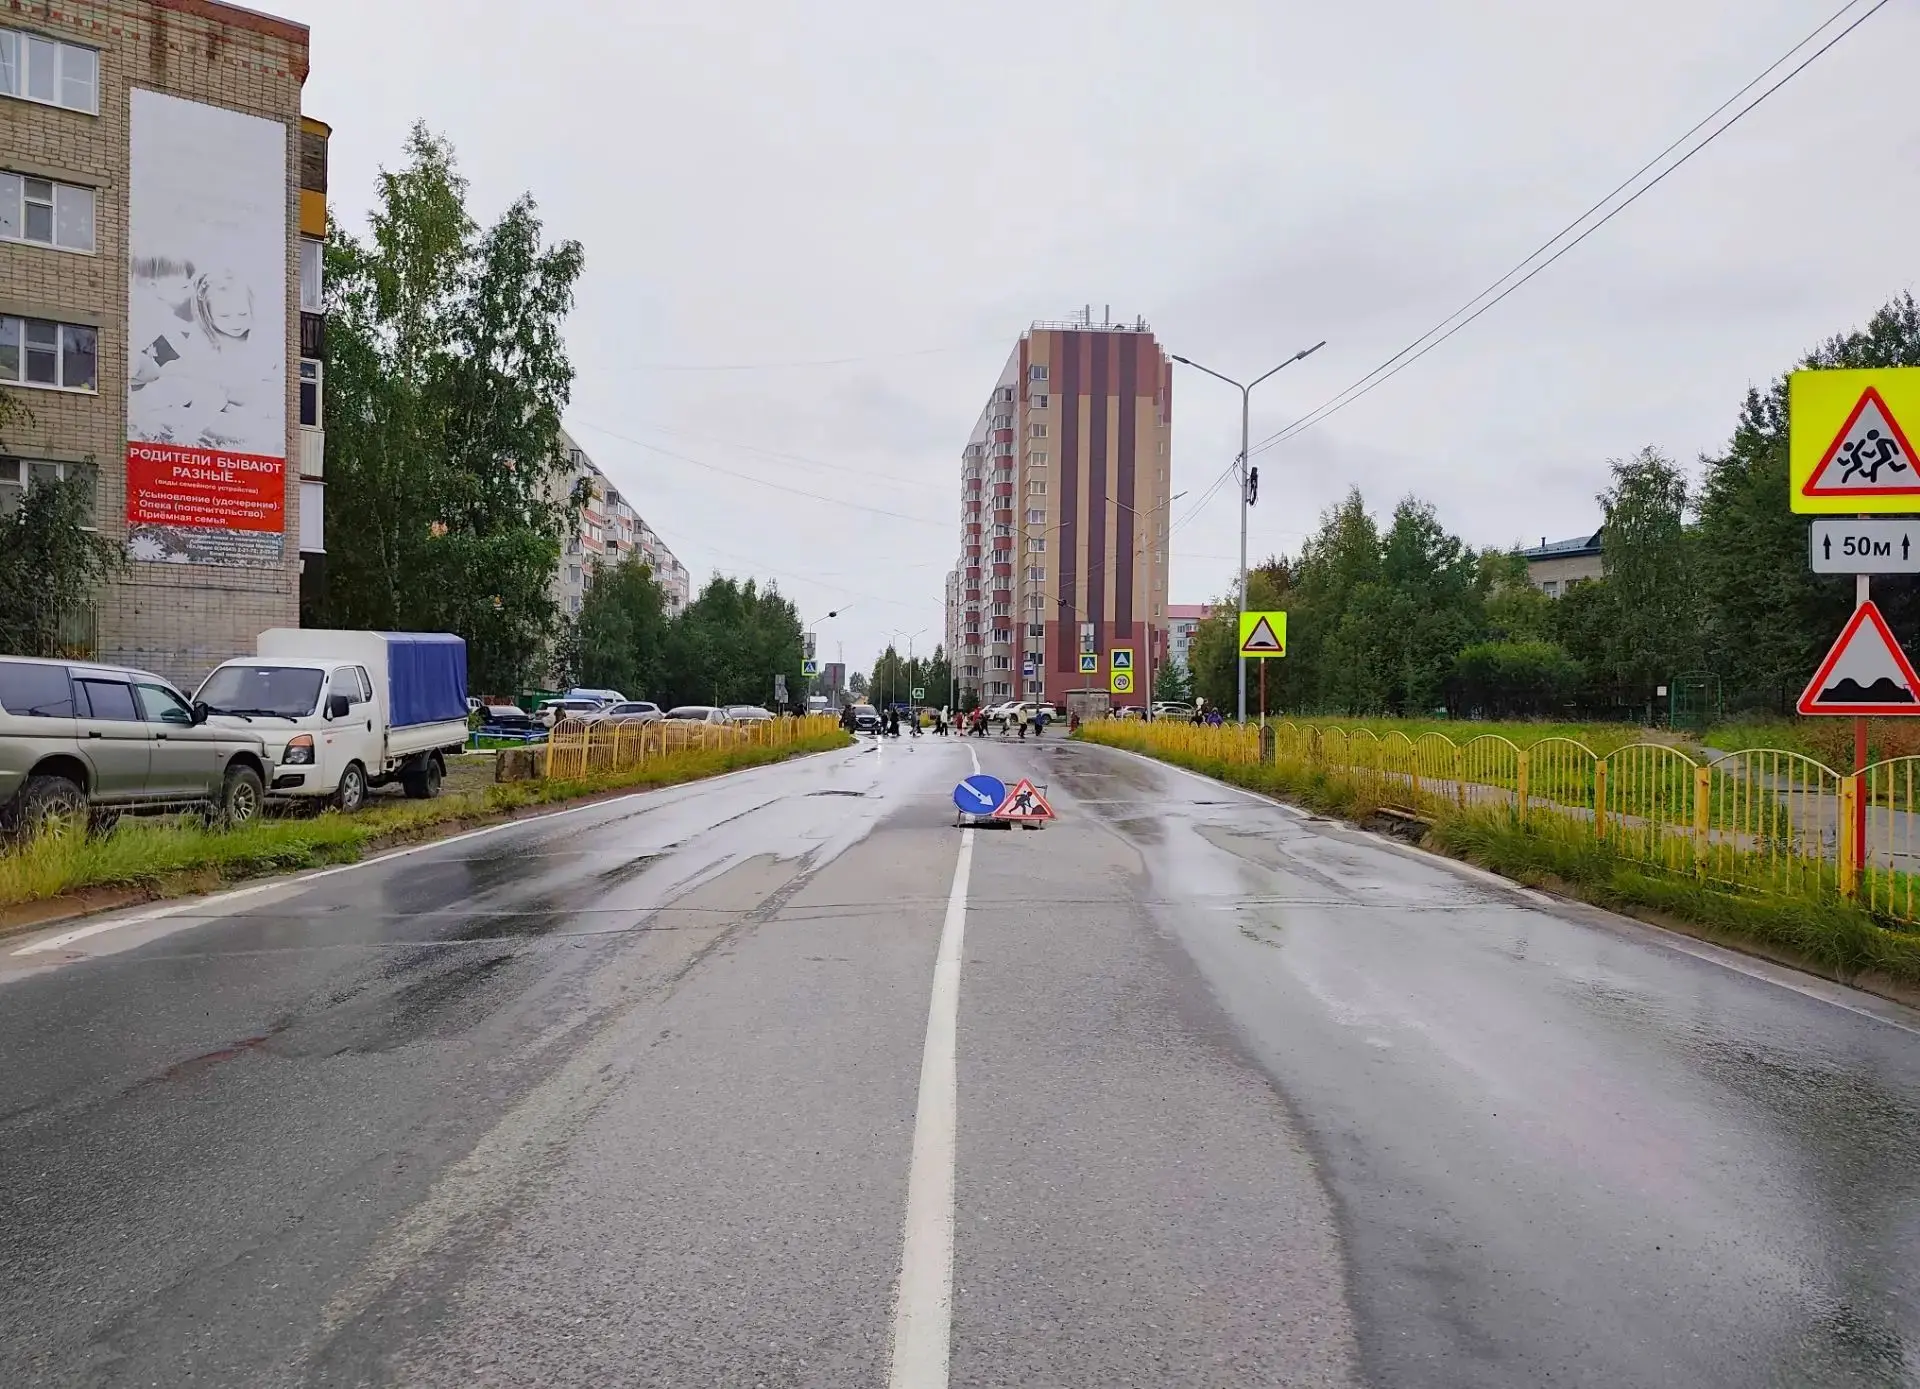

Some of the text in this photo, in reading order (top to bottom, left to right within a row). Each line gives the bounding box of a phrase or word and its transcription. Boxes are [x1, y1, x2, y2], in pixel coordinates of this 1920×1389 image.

[130, 447, 282, 474] РОДИТЕЛИ БЫВАЮТ
[172, 466, 245, 484] РАЗНЫЕ...
[155, 478, 179, 487] (виды
[179, 481, 216, 491] семейного
[139, 489, 210, 504] Усыновление
[139, 499, 171, 510] Опека
[139, 509, 229, 525] Приёмная семья.
[1843, 536, 1890, 556] 50м
[1117, 678, 1127, 686] 20
